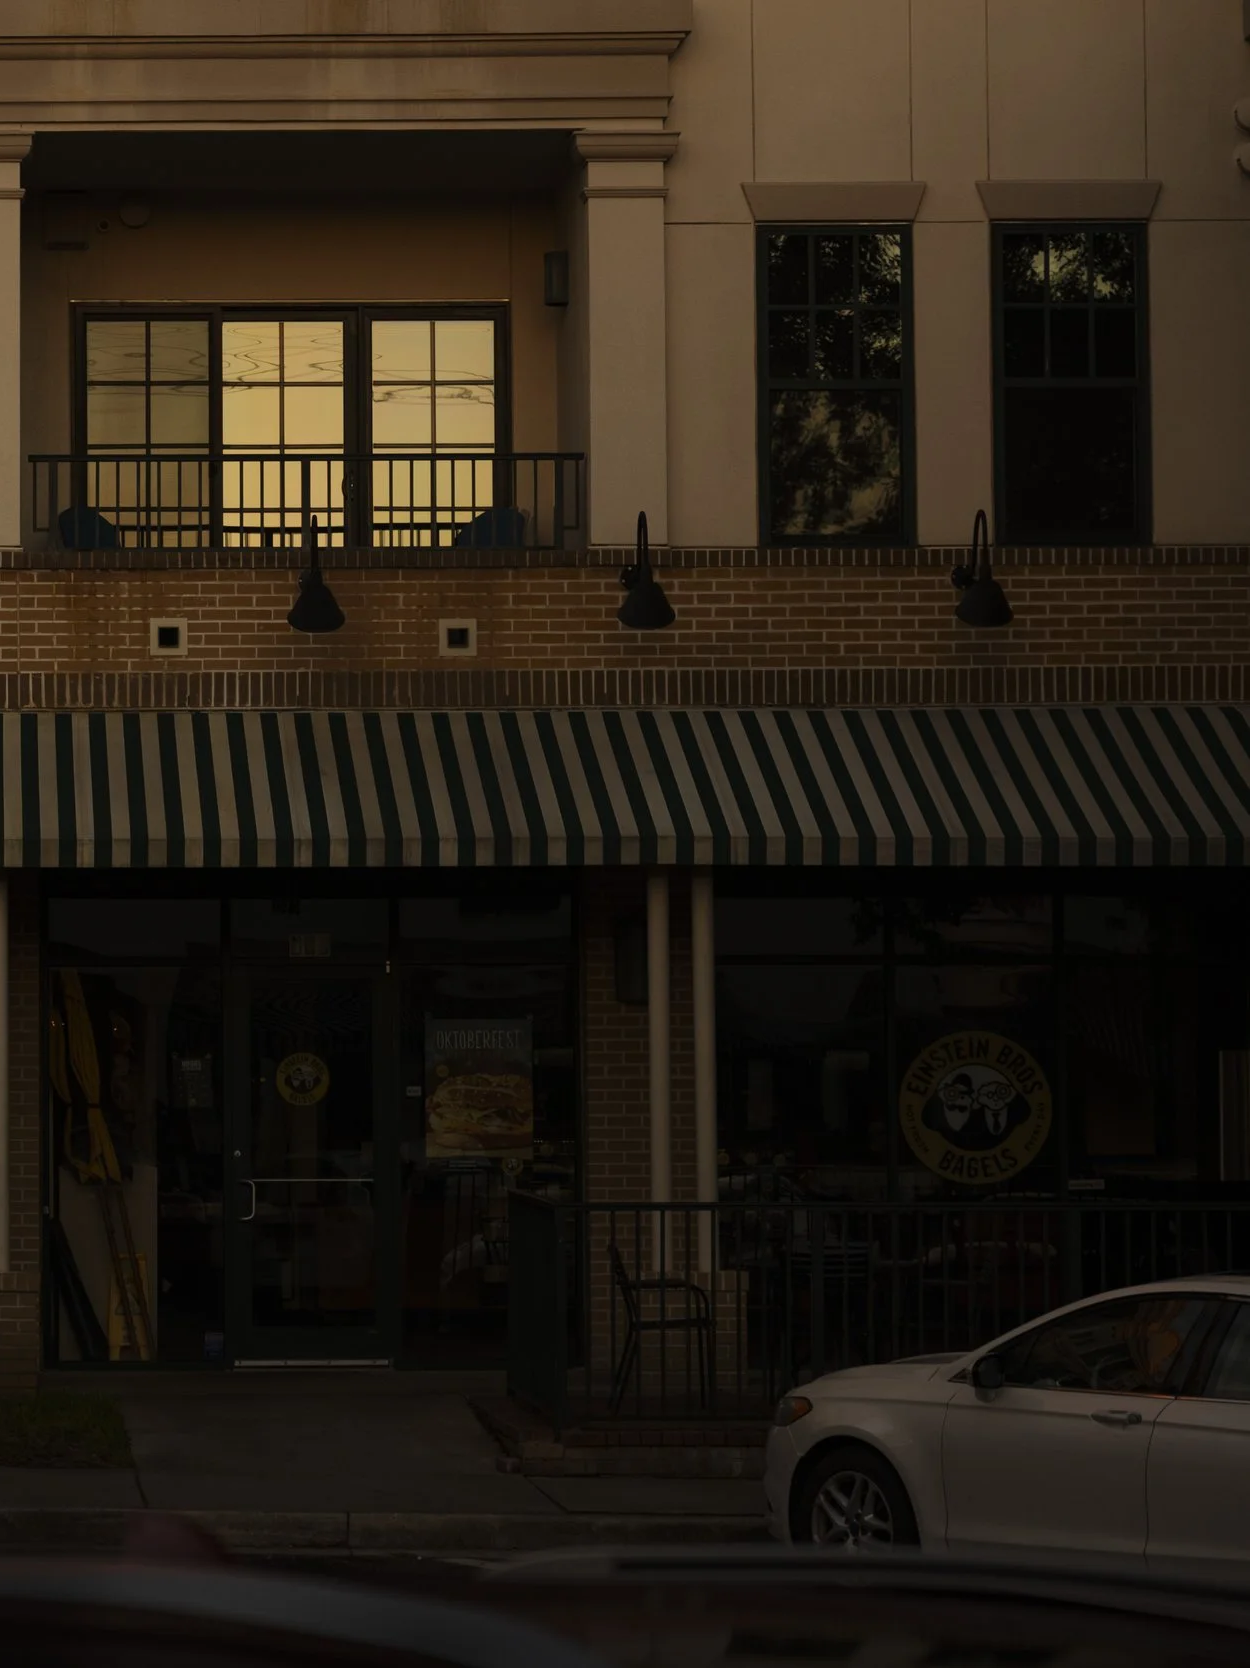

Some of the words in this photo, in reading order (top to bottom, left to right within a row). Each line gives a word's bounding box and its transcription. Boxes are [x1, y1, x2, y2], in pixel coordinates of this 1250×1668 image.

[436, 1029, 523, 1049] OKTOBERFEST
[907, 1037, 990, 1096] EINSTEIN
[996, 1044, 1044, 1095] BROS
[939, 1148, 1018, 1178] BAGELS
